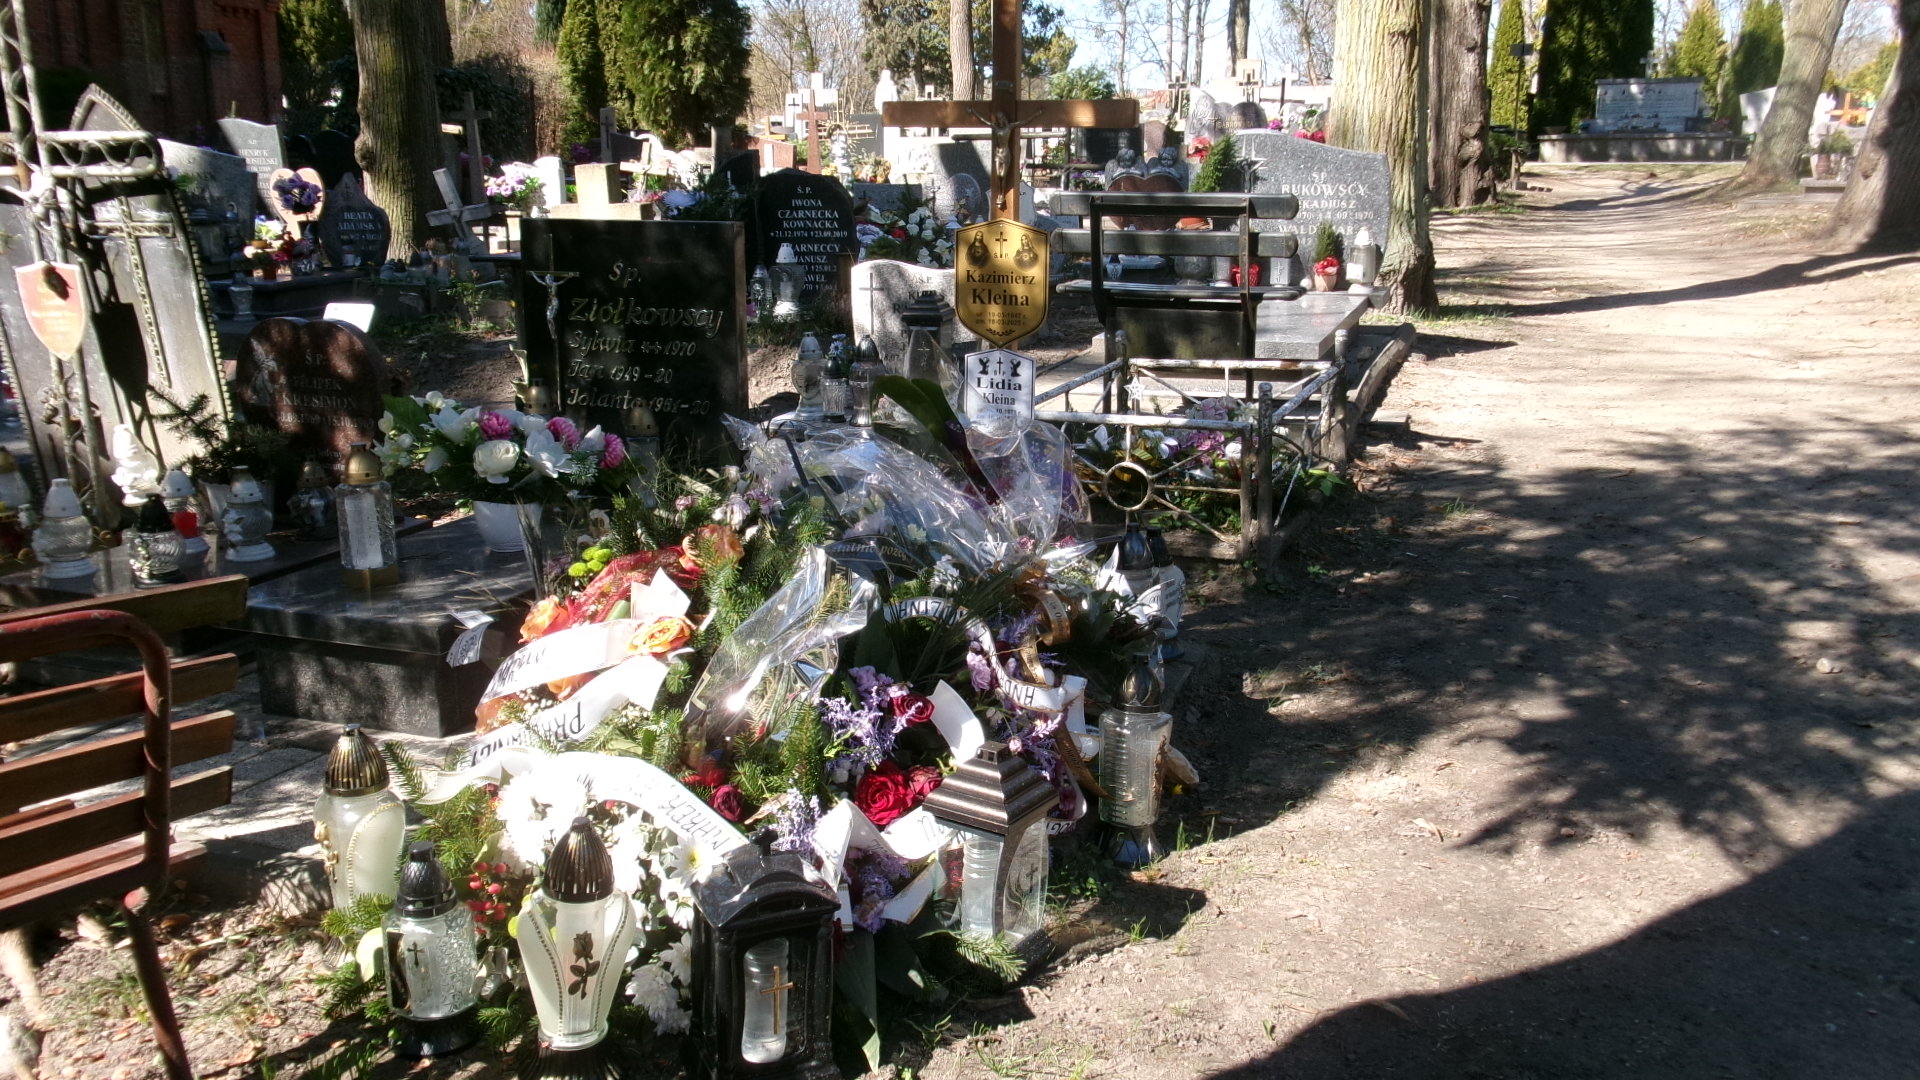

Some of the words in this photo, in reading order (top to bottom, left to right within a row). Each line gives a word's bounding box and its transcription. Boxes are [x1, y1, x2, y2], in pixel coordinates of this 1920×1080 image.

[791, 199, 823, 207] IWONA
[1299, 200, 1357, 209] KADIUSZ
[778, 210, 839, 219] CZARNECKA
[783, 220, 839, 229] KOWNACKA
[1279, 225, 1355, 235] WALDAR
[966, 269, 1036, 285] Kazimierz
[972, 289, 1029, 306] Kleina
[976, 377, 1022, 391] Lidia
[983, 393, 1016, 406] Kleina
